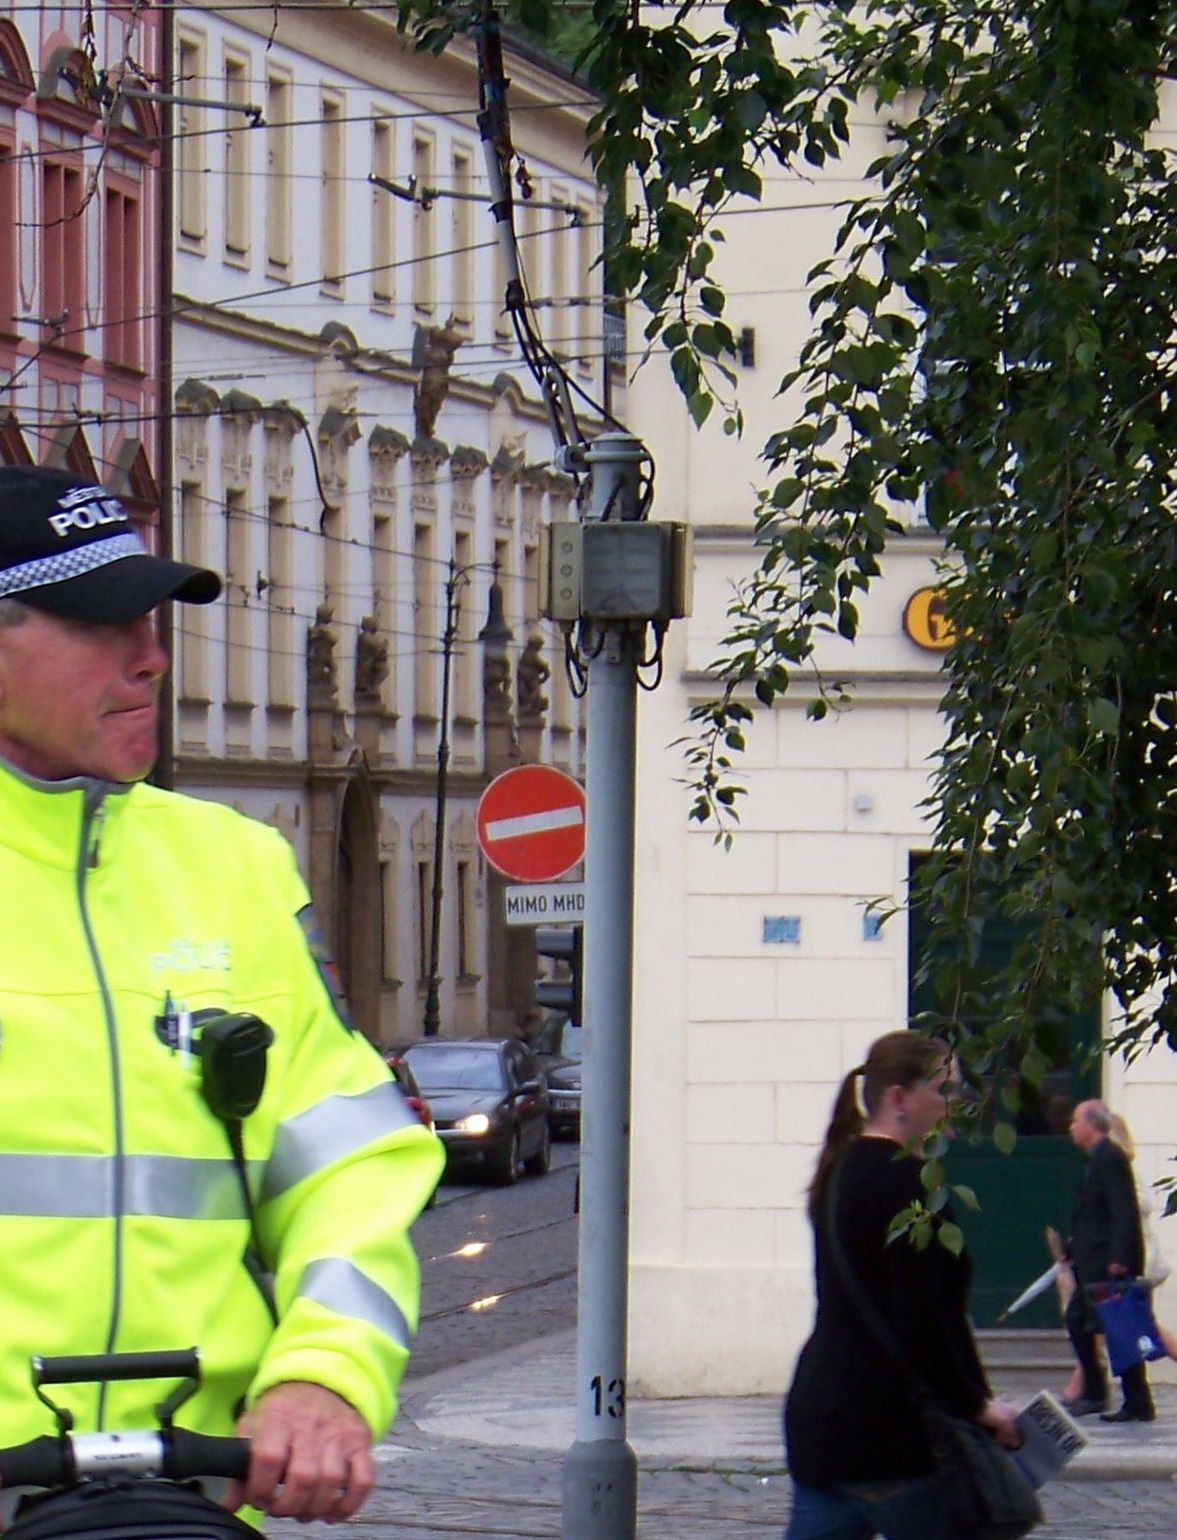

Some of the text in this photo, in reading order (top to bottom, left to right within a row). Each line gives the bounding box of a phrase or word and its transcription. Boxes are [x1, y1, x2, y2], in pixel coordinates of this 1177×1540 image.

[507, 893, 585, 914] MIMO MHD
[590, 1375, 626, 1419] 13
